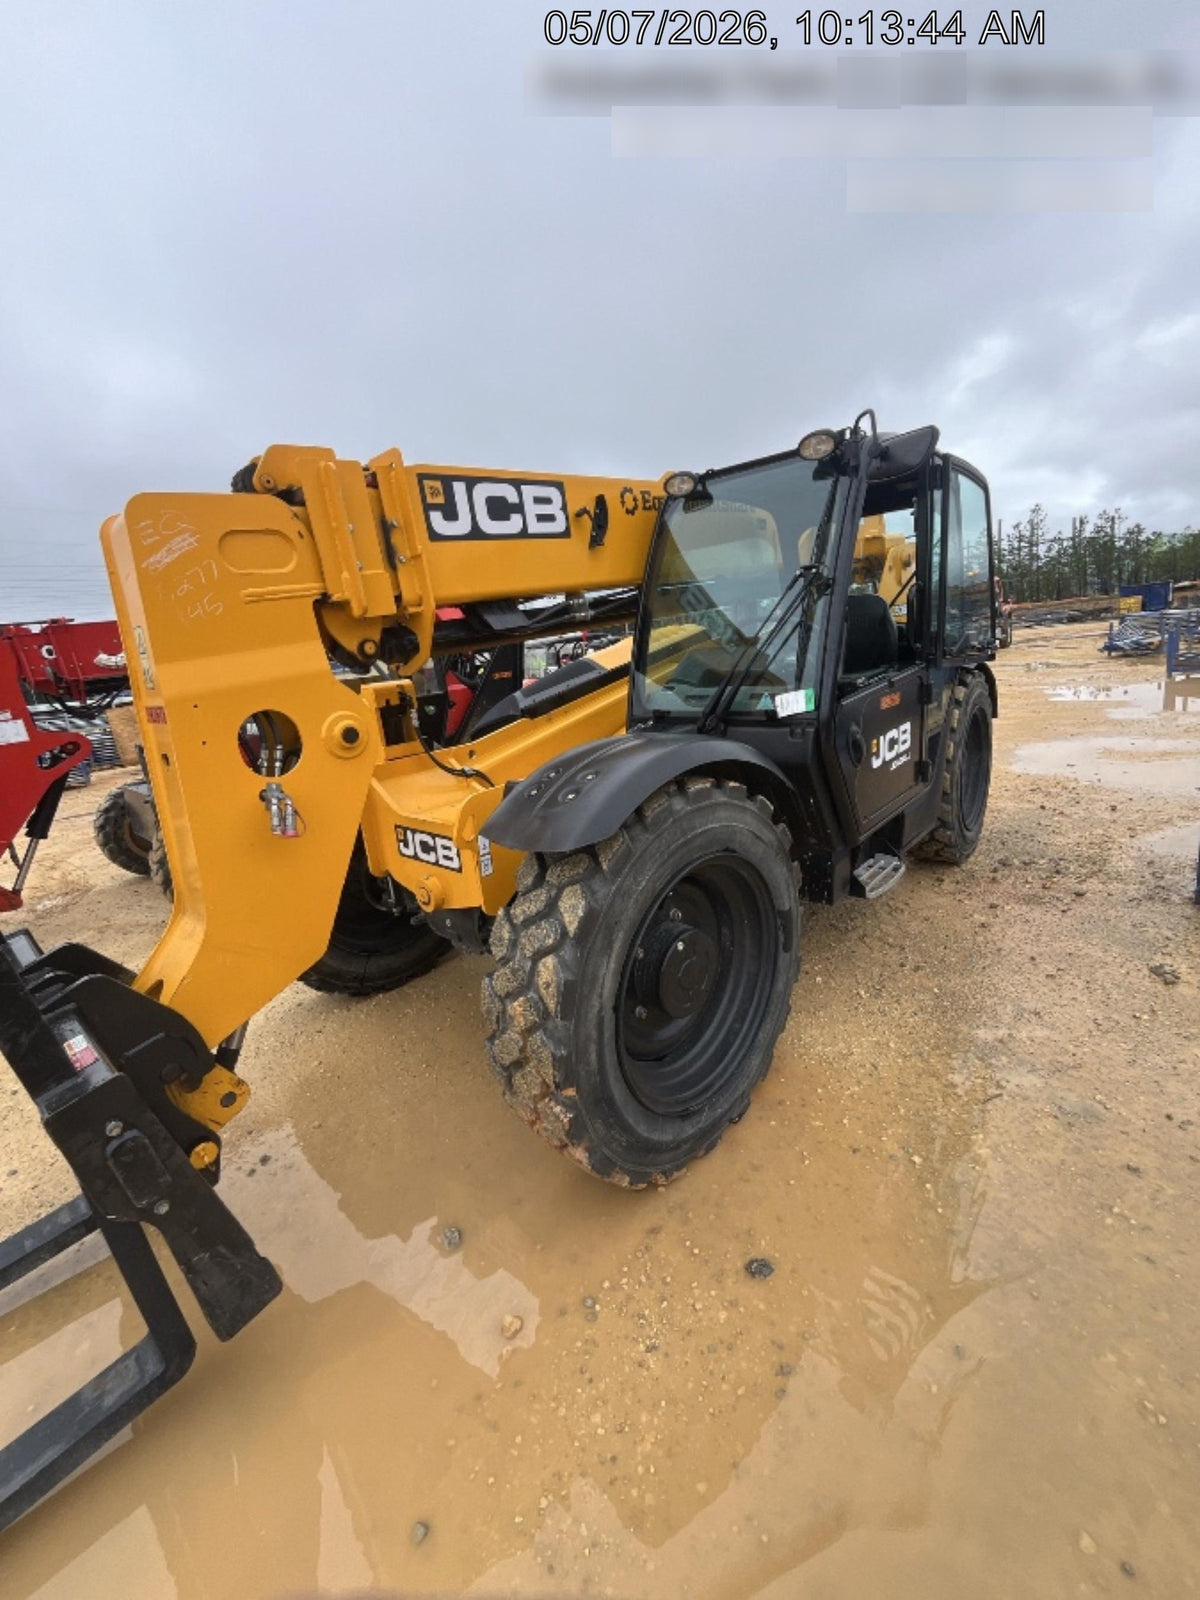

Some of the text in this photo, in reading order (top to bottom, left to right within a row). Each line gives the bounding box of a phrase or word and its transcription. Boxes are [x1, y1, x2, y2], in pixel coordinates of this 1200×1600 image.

[428, 481, 567, 535] JCB
[871, 721, 912, 769] JCB
[399, 829, 461, 870] JCB
